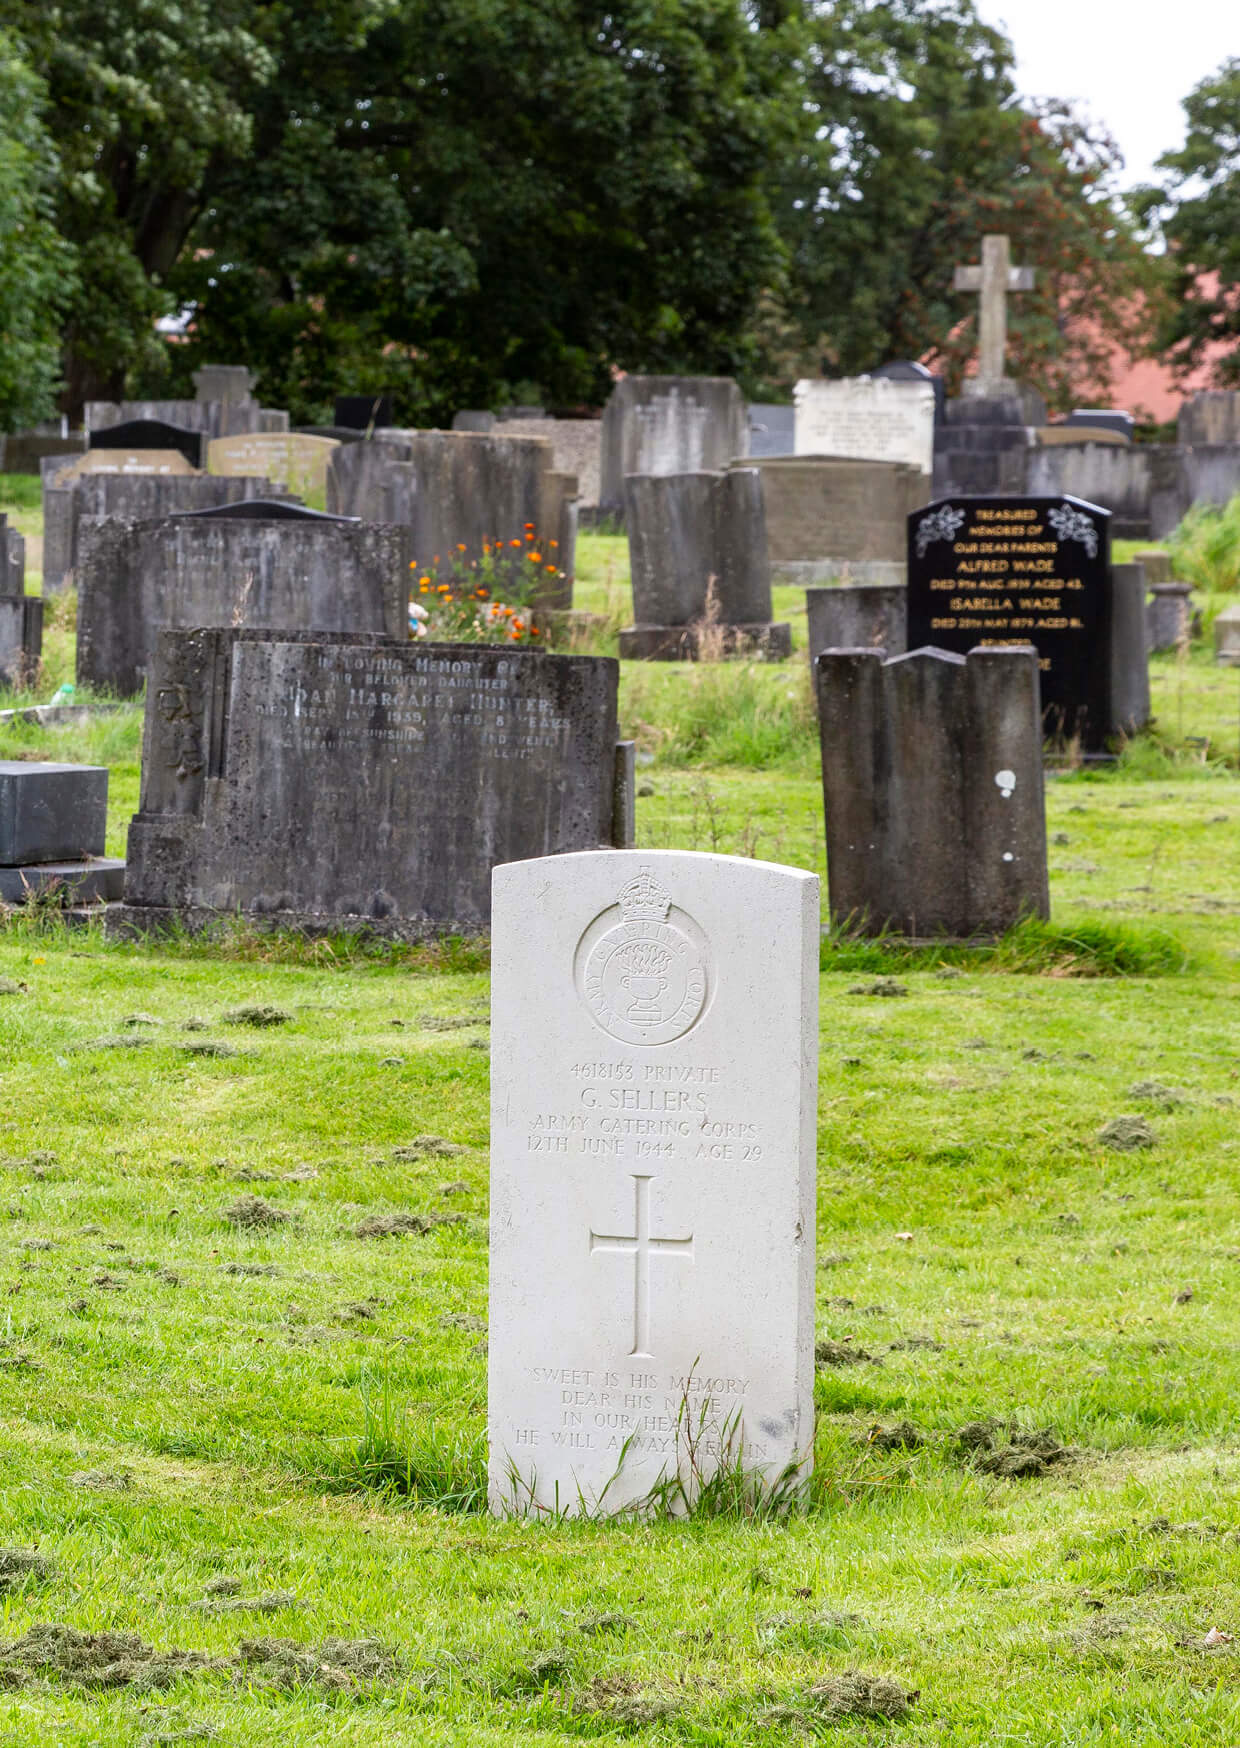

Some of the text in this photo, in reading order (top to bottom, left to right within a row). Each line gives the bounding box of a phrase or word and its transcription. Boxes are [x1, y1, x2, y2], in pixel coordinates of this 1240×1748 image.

[975, 508, 1038, 521] TREASURED
[968, 524, 1044, 537] MEMORIES OF
[953, 541, 1058, 554] OUR DEAR PARENTS
[956, 559, 1056, 573] ALFRED WADE
[930, 578, 956, 590] DIED
[1032, 578, 1064, 590] AGED
[949, 597, 1061, 611] ISABELLA WADE
[931, 616, 957, 629] DIED
[983, 616, 1009, 629] MAY
[1035, 616, 1068, 629] AGED
[318, 656, 334, 671] IN
[344, 657, 403, 673] LOVING
[416, 658, 481, 674] MEMORY
[365, 673, 427, 687] BELOVED
[438, 676, 508, 689] DAUGHTER
[348, 687, 455, 709] MARGARET
[570, 1062, 721, 1083] 4618153 PRIVATE
[580, 1087, 709, 1113] G. SELLERS
[532, 1115, 760, 1140] ARMY CATERING CORPS
[527, 1136, 762, 1163] 12TH JUNE 1944 AGE 29
[532, 1367, 751, 1395] SWEET IS HIS MEMORY
[561, 1390, 721, 1414] DEAR HIS NME
[562, 1411, 720, 1435] IN OUR HEARTS
[516, 1429, 539, 1445] HE
[551, 1431, 595, 1449] WILL
[607, 1435, 679, 1454] ALWAYS
